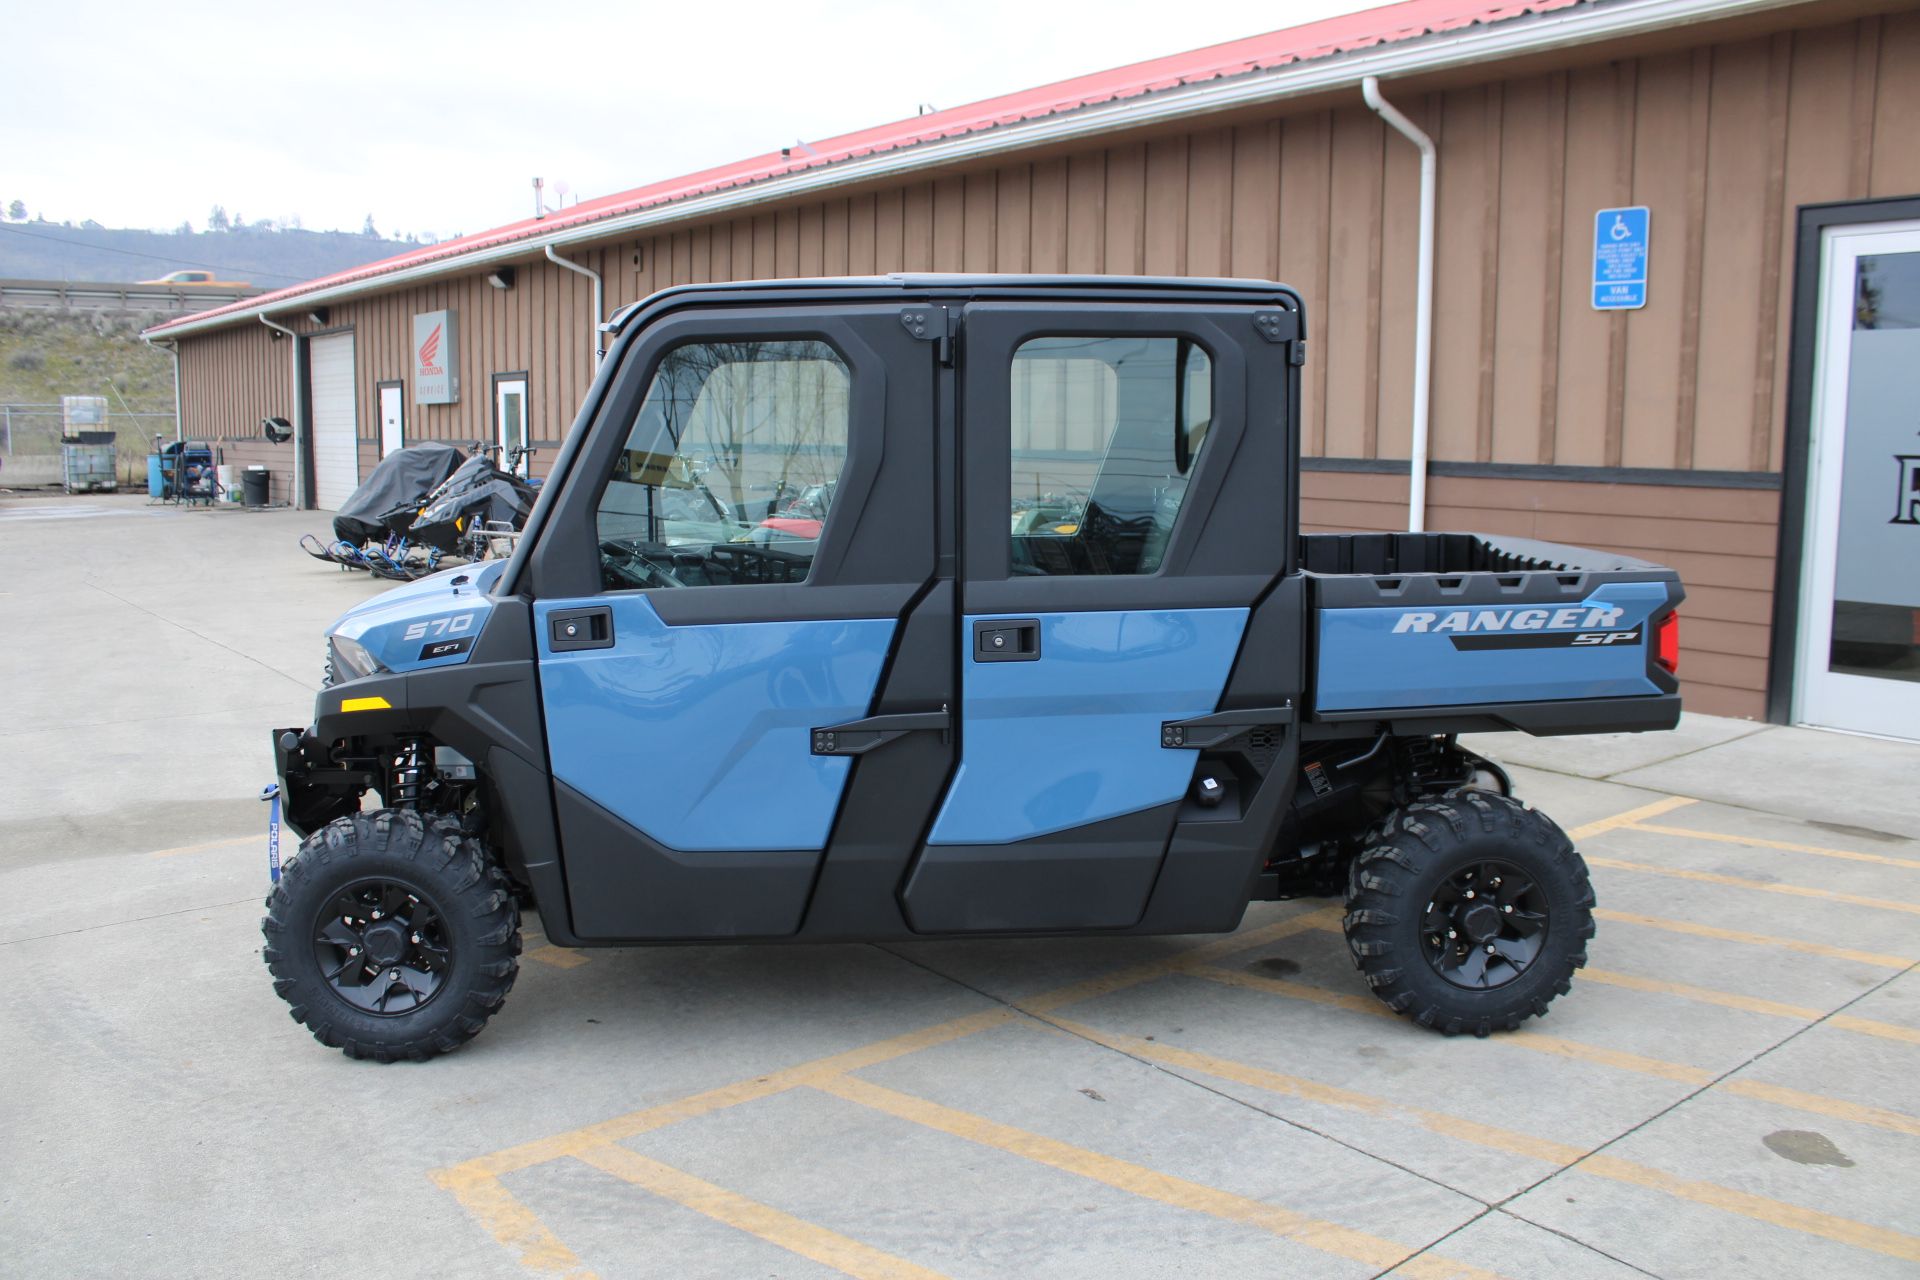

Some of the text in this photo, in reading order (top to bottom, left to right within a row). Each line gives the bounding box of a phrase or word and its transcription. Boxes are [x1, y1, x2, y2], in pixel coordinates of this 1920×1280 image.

[419, 367, 443, 376] HONDA
[403, 613, 474, 640] 570
[1391, 607, 1624, 633] RANGER
[1571, 632, 1638, 645] SP
[432, 643, 459, 653] EFI
